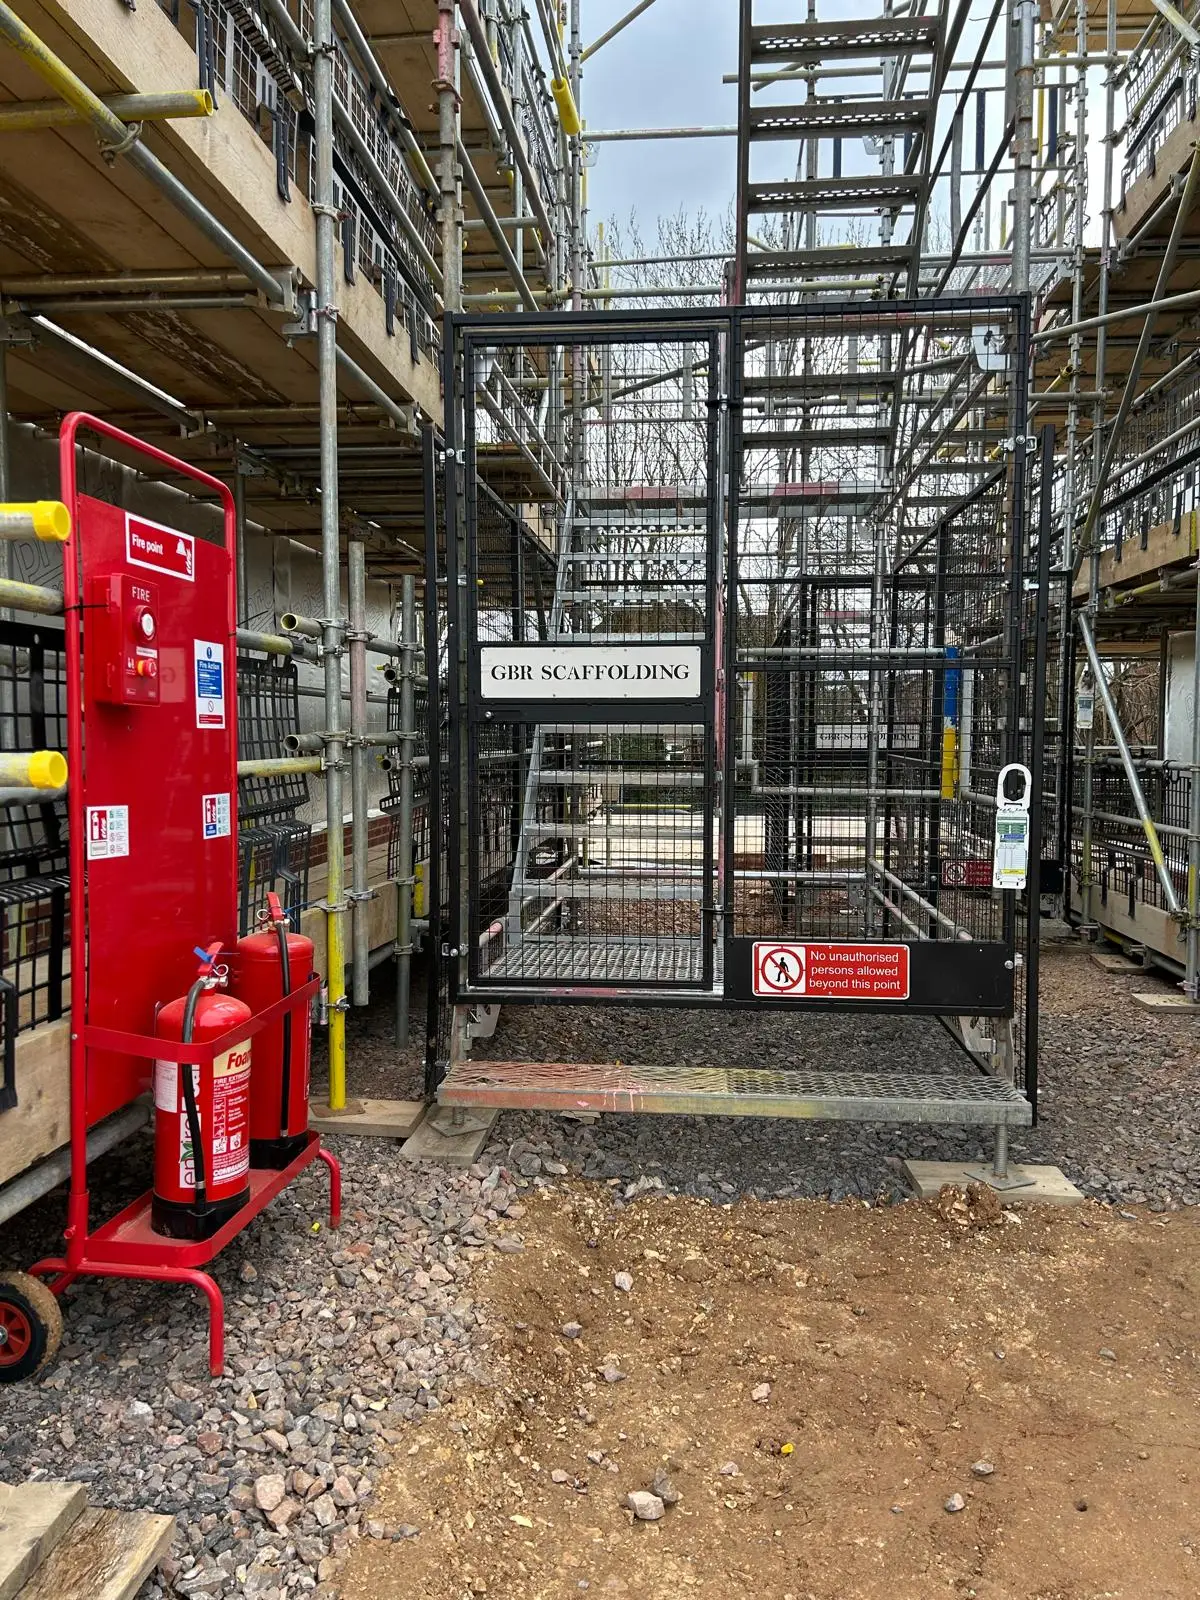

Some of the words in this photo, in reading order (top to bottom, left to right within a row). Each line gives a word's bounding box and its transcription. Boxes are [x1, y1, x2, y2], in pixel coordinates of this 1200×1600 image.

[132, 533, 146, 549] Fire
[146, 541, 164, 555] point
[132, 586, 151, 602] FIRE
[490, 665, 534, 680] GBR
[541, 664, 690, 680] SCAFFOLDING
[810, 950, 826, 961] No
[829, 951, 899, 963] unauthorised
[811, 966, 854, 977] persons
[857, 966, 898, 976] allowed
[809, 978, 848, 990] beyond
[852, 979, 871, 989] this
[873, 979, 901, 991] point
[227, 1051, 251, 1069] Foa
